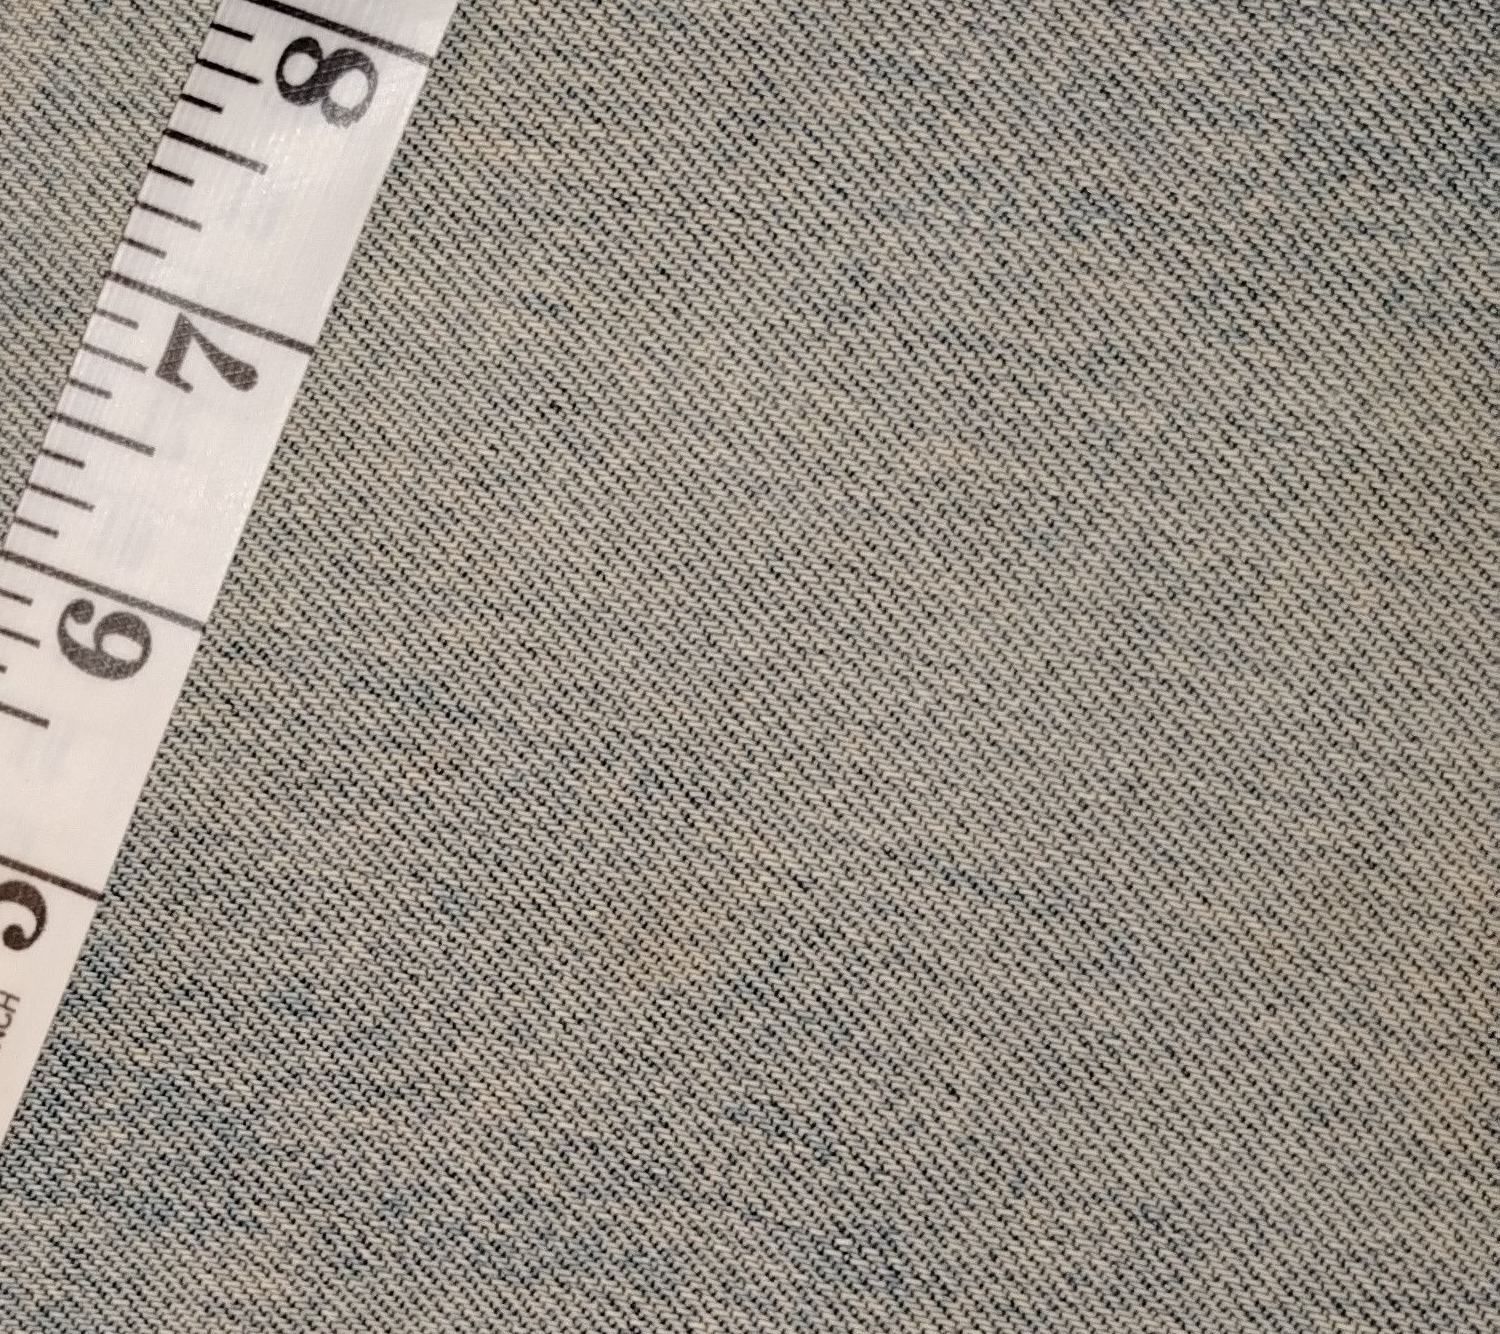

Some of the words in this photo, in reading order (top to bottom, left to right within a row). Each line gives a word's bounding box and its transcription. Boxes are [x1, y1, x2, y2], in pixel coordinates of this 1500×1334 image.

[275, 36, 379, 129] 8
[154, 315, 257, 393] 7
[57, 598, 153, 681] 6
